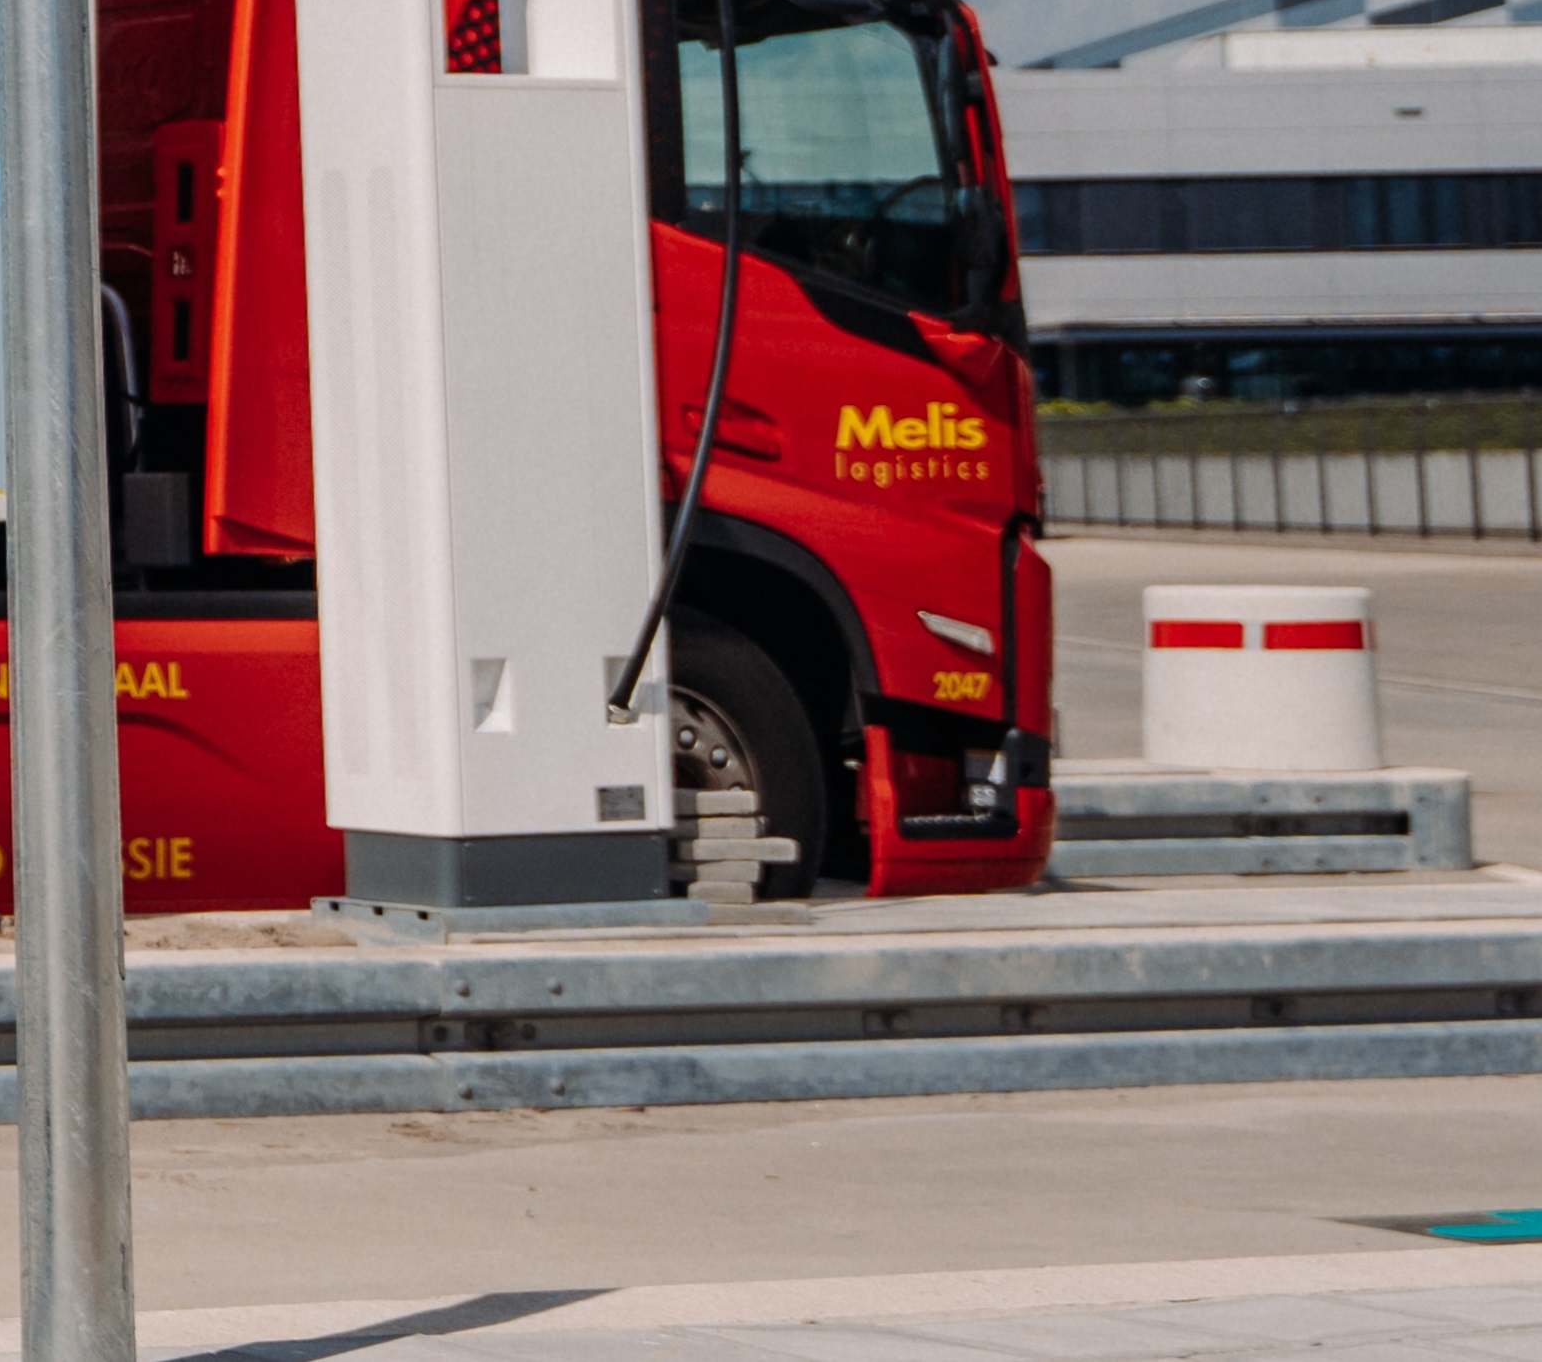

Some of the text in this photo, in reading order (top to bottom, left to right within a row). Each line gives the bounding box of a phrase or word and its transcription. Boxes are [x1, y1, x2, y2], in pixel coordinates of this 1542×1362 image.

[835, 400, 988, 451] Melis
[835, 453, 990, 488] logistics
[932, 671, 992, 701] 2047
